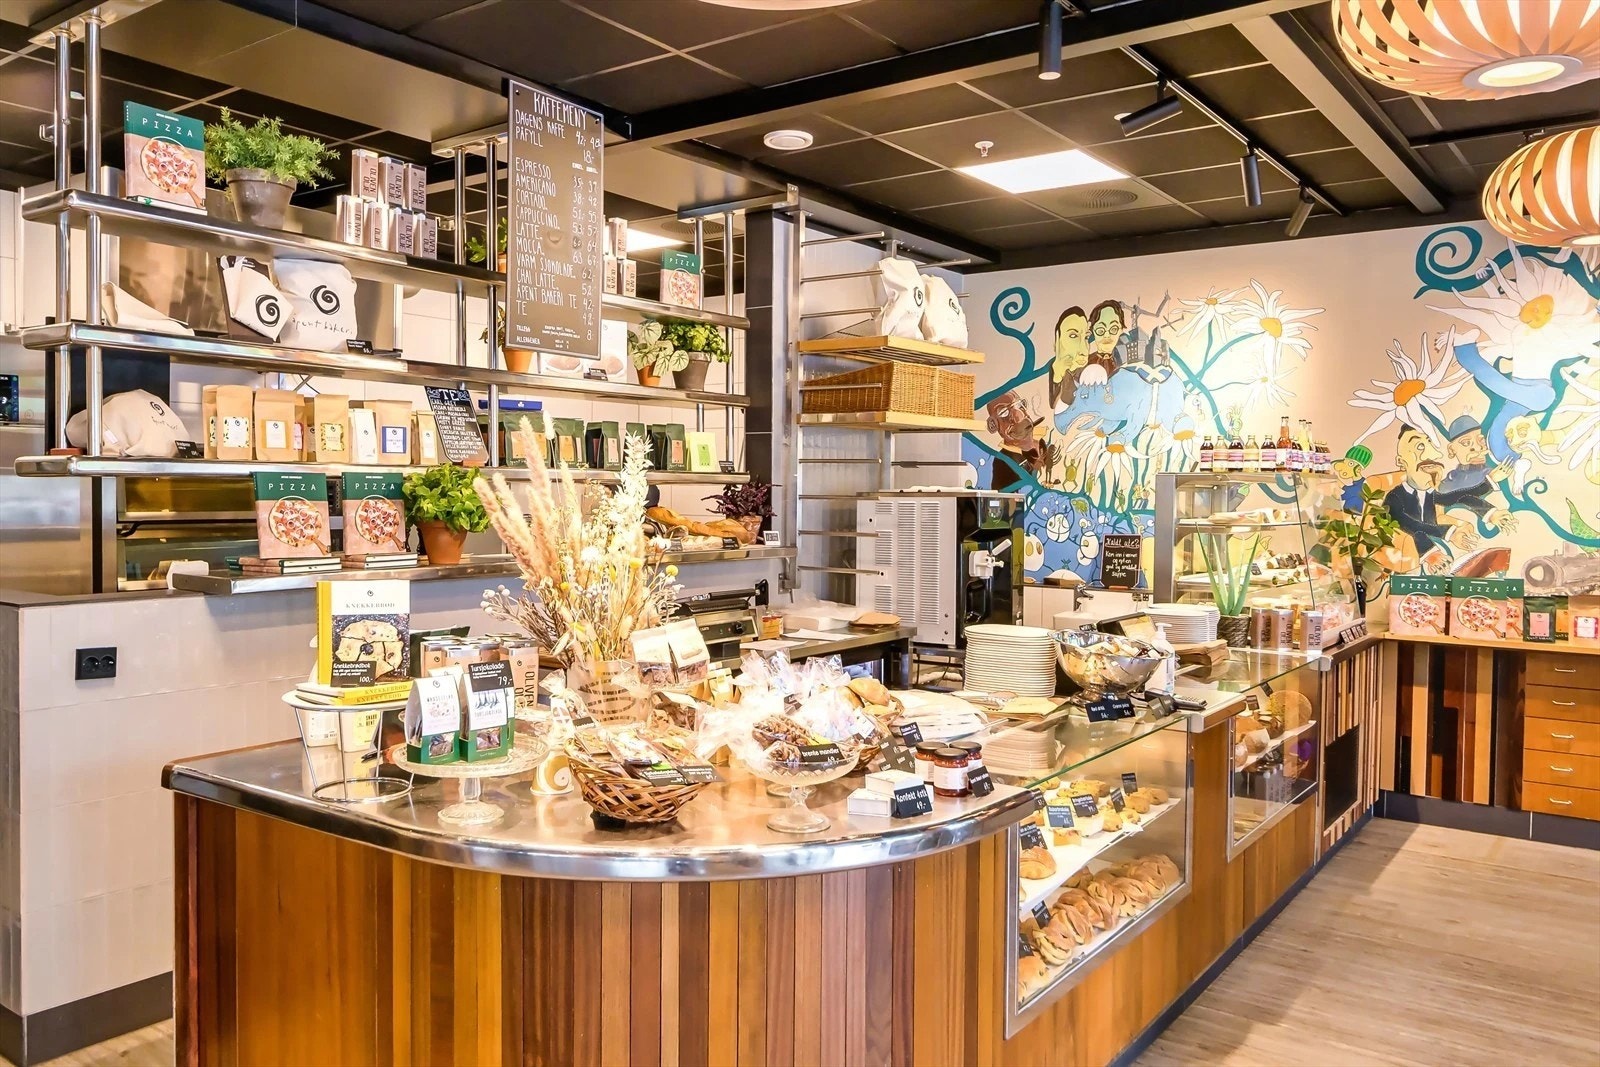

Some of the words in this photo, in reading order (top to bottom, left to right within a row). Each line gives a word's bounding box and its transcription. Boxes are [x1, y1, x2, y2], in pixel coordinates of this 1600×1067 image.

[534, 92, 586, 130] KAFFEMENY
[142, 117, 193, 138] PIZZA
[516, 109, 543, 131] DAGENS
[547, 121, 565, 139] KAFFE
[516, 126, 543, 147] PÅFYLL
[515, 157, 551, 180] ESPRESSO
[369, 168, 377, 193] OLIVEN
[428, 230, 436, 254] OLIVEN
[516, 252, 537, 270] VARM
[669, 257, 695, 267] PIZZA
[517, 268, 532, 284] CHAI
[517, 284, 538, 302] ÅPENT
[568, 293, 577, 309] TE
[516, 300, 528, 316] TE
[438, 389, 459, 401] TE
[268, 483, 316, 491] PIZZA
[355, 482, 395, 490] PIZZA
[1459, 585, 1499, 593] PIZZA
[470, 662, 504, 673] Tursjokolade
[524, 671, 535, 707] OLIVEN
[896, 791, 916, 803] Konfekt
